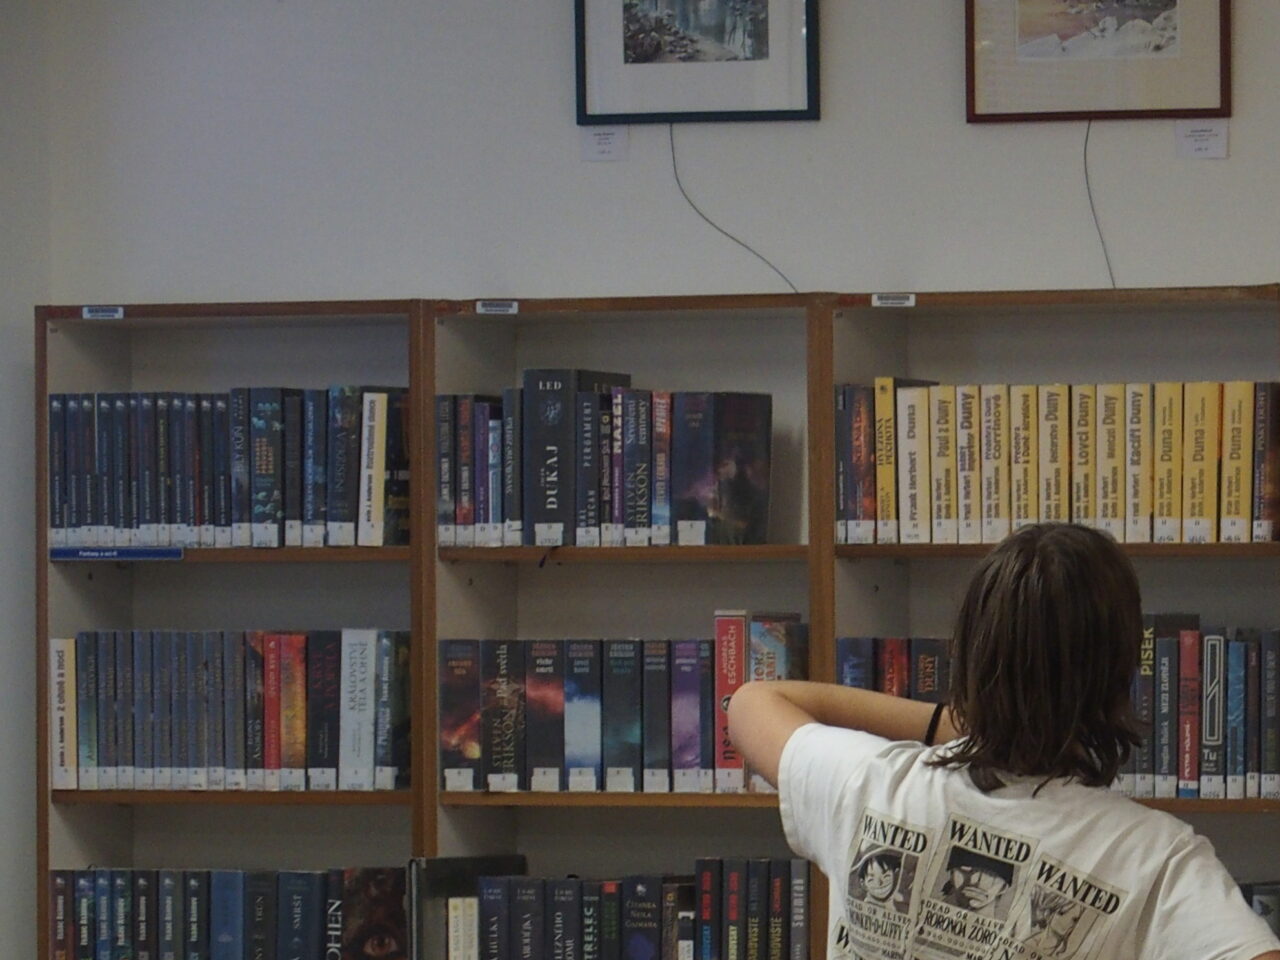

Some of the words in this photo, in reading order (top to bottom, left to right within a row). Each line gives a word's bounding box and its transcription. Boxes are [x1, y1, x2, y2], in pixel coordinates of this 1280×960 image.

[538, 381, 563, 391] LED
[906, 405, 916, 439] Duna
[937, 400, 952, 424] Duny
[960, 393, 975, 429] Duny
[1045, 392, 1061, 421] Duny
[1077, 394, 1091, 428] Duny
[1103, 396, 1119, 425] Duny
[1129, 392, 1143, 425] Duny
[583, 401, 593, 467] PERGAMENT
[1077, 431, 1090, 466] Lovci
[1160, 428, 1173, 463] Duna
[1191, 428, 1205, 463] Duna
[1229, 427, 1242, 461] Duna
[545, 445, 559, 510] DUKAJ
[496, 644, 509, 676] světla
[728, 625, 737, 685] ESCHBACH
[346, 642, 357, 712] KRÁLOVSTVÍ
[491, 718, 500, 767] STEVEN
[863, 814, 928, 854] WANTED
[949, 820, 1031, 863] WANTED
[792, 879, 804, 927] Soumrak
[1036, 861, 1122, 914] WANTED
[926, 901, 953, 916] DEAD
[956, 911, 970, 920] OR
[923, 912, 966, 938] RORONOA
[967, 923, 997, 946] ZORO
[1003, 938, 1026, 955] DEAD
[1030, 950, 1042, 960] OR
